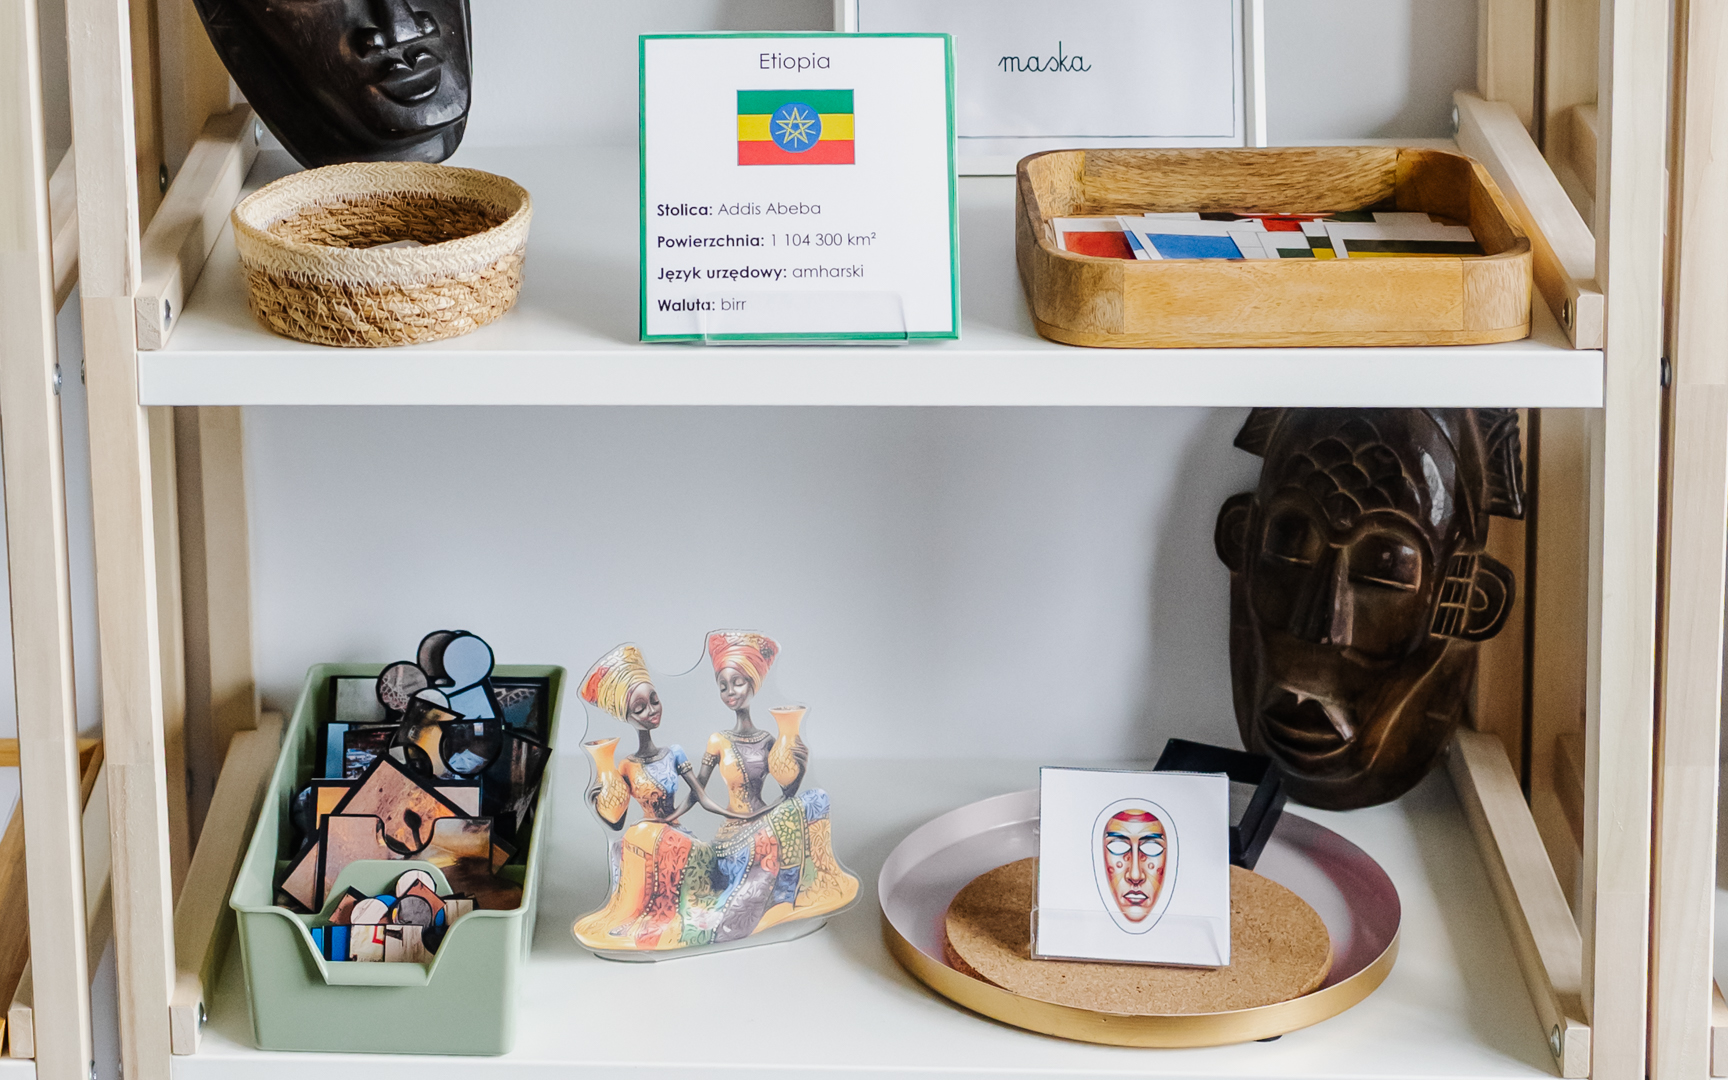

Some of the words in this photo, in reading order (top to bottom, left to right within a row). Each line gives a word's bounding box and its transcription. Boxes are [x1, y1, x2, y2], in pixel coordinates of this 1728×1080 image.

[759, 52, 831, 73] Etiopia
[997, 40, 1092, 73] maska
[656, 203, 713, 217] Stolica:
[717, 202, 762, 216] Addis
[765, 201, 821, 215] Abeba
[657, 233, 765, 249] Powierzchnia:
[785, 233, 811, 247] 104
[815, 232, 843, 247] 300
[657, 266, 702, 283] Język
[706, 265, 787, 282] urzędowy:
[792, 264, 864, 279] amharski
[657, 298, 716, 312] Waluta:
[720, 297, 747, 311] birr
